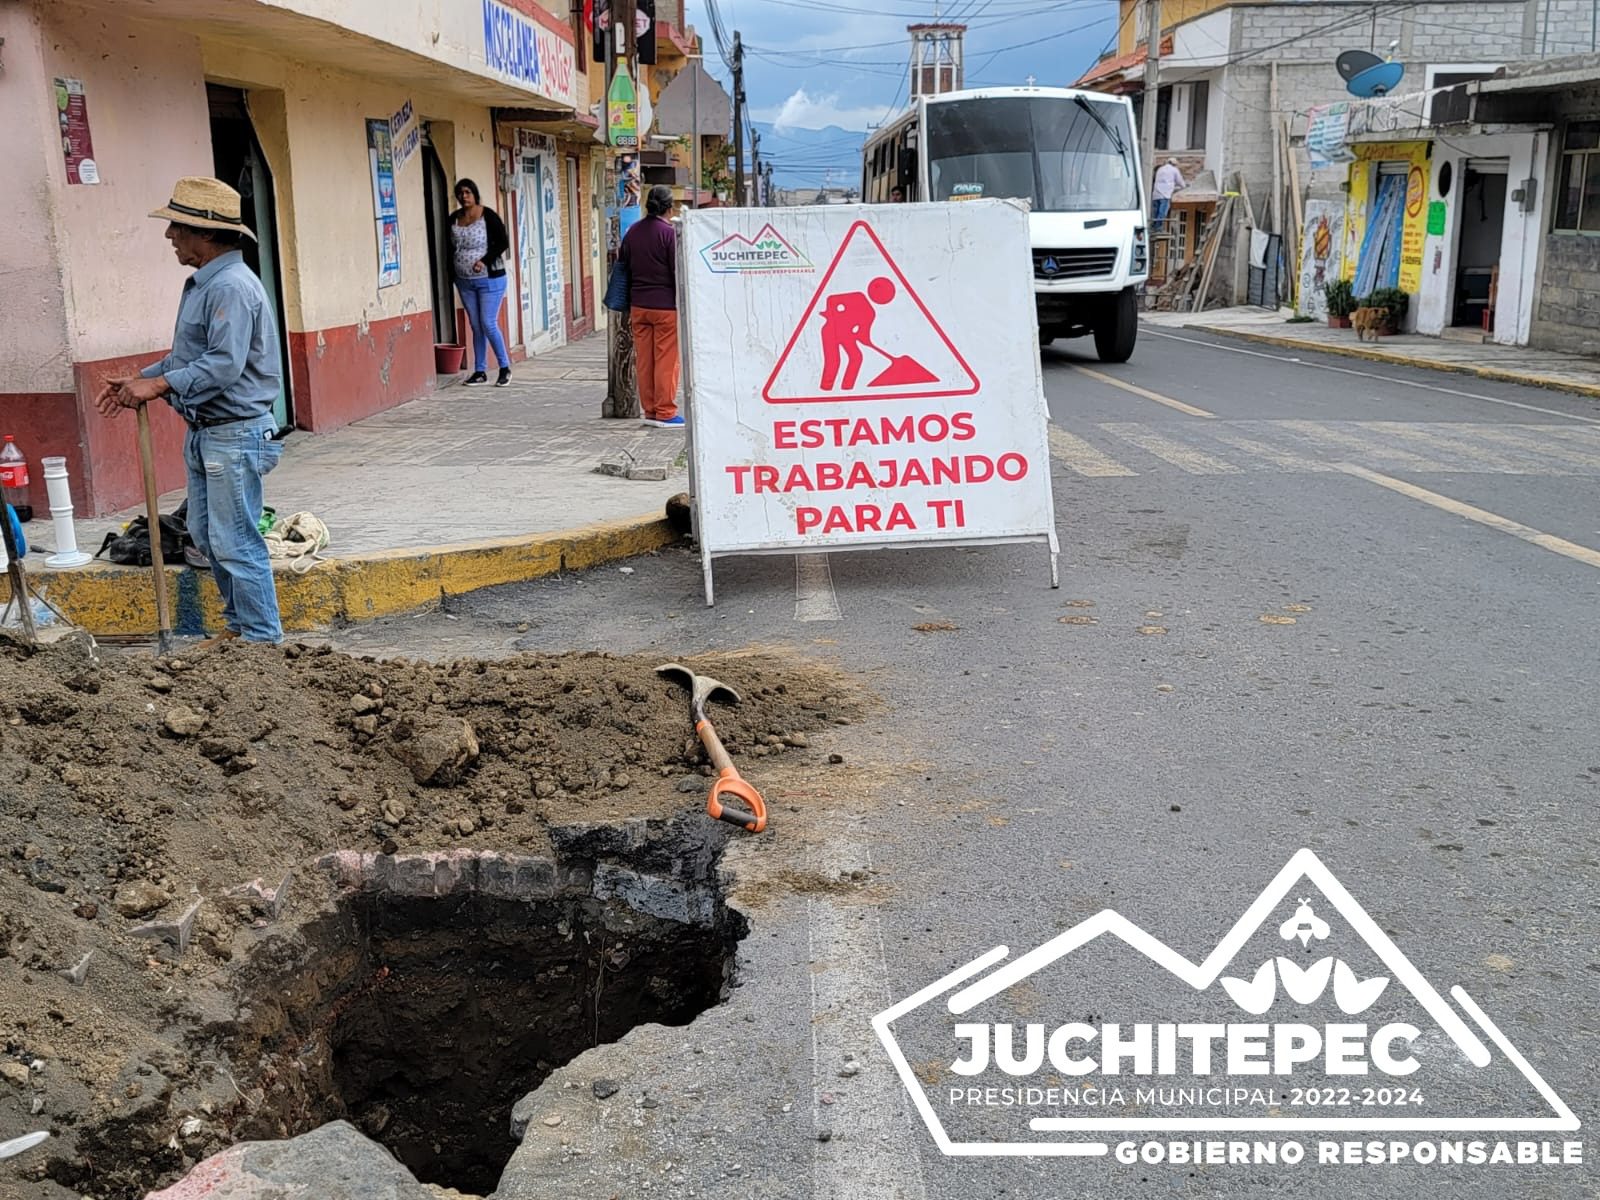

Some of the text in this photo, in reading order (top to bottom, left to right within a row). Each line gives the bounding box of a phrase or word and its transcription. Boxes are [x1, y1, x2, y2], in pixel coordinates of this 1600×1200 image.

[712, 250, 788, 261] JUCHITEPEC
[774, 412, 976, 449] ESTAMOS
[725, 452, 1029, 494] TRABAJANDO
[796, 499, 965, 535] PARA TI
